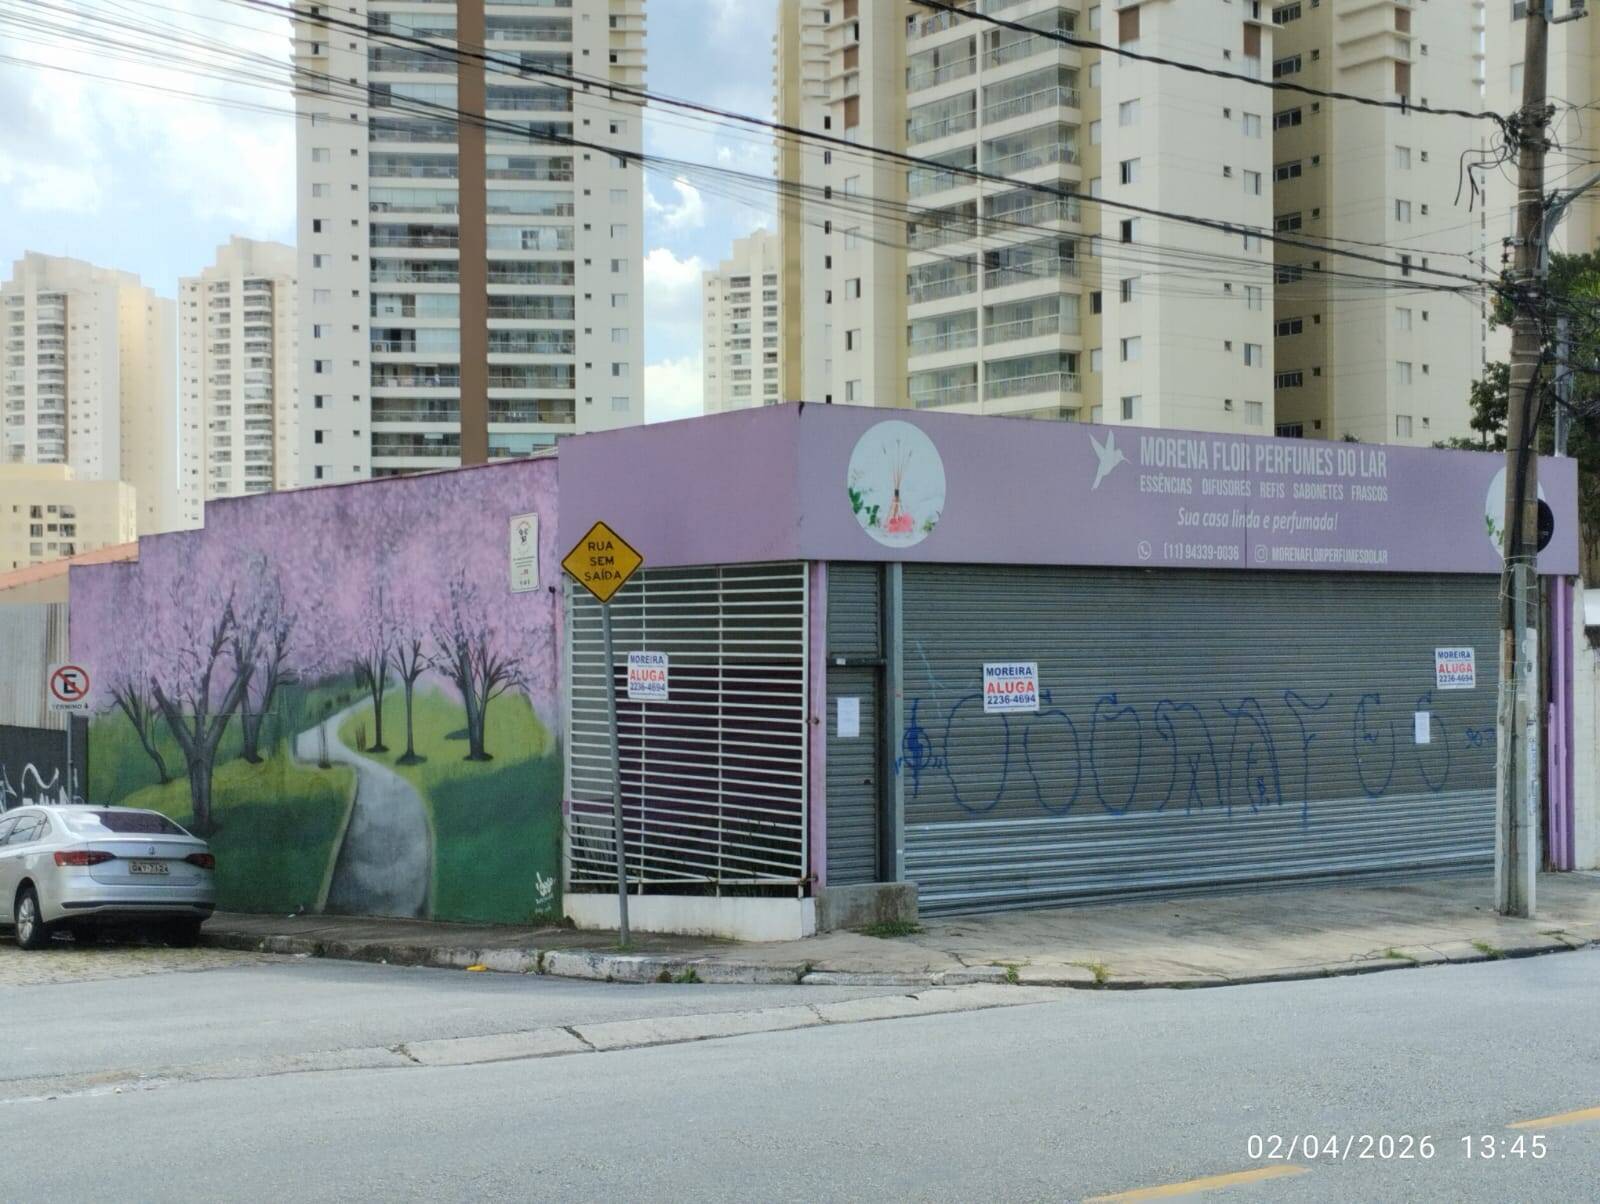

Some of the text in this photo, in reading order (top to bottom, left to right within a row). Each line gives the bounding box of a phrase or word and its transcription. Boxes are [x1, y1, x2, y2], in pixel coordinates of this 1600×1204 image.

[1140, 436, 1387, 478] MORENA FLOR PERFUMES DO LAR
[1140, 473, 1388, 502] ESSÊNCIAS DIFUSORES REFIS SABONETES FRASCOS
[1177, 507, 1338, 534] Sua casa linda e perfumada!
[588, 541, 614, 552] RUA
[589, 556, 615, 567] SEM
[584, 568, 622, 582] SAÍDA
[630, 655, 664, 664] MOREIRA
[1437, 651, 1472, 659] MOREIRA
[986, 666, 1033, 677] MOREIRA
[1438, 663, 1473, 673] ALUGA
[630, 669, 665, 681] ALUGA
[987, 680, 1035, 694] ALUGA
